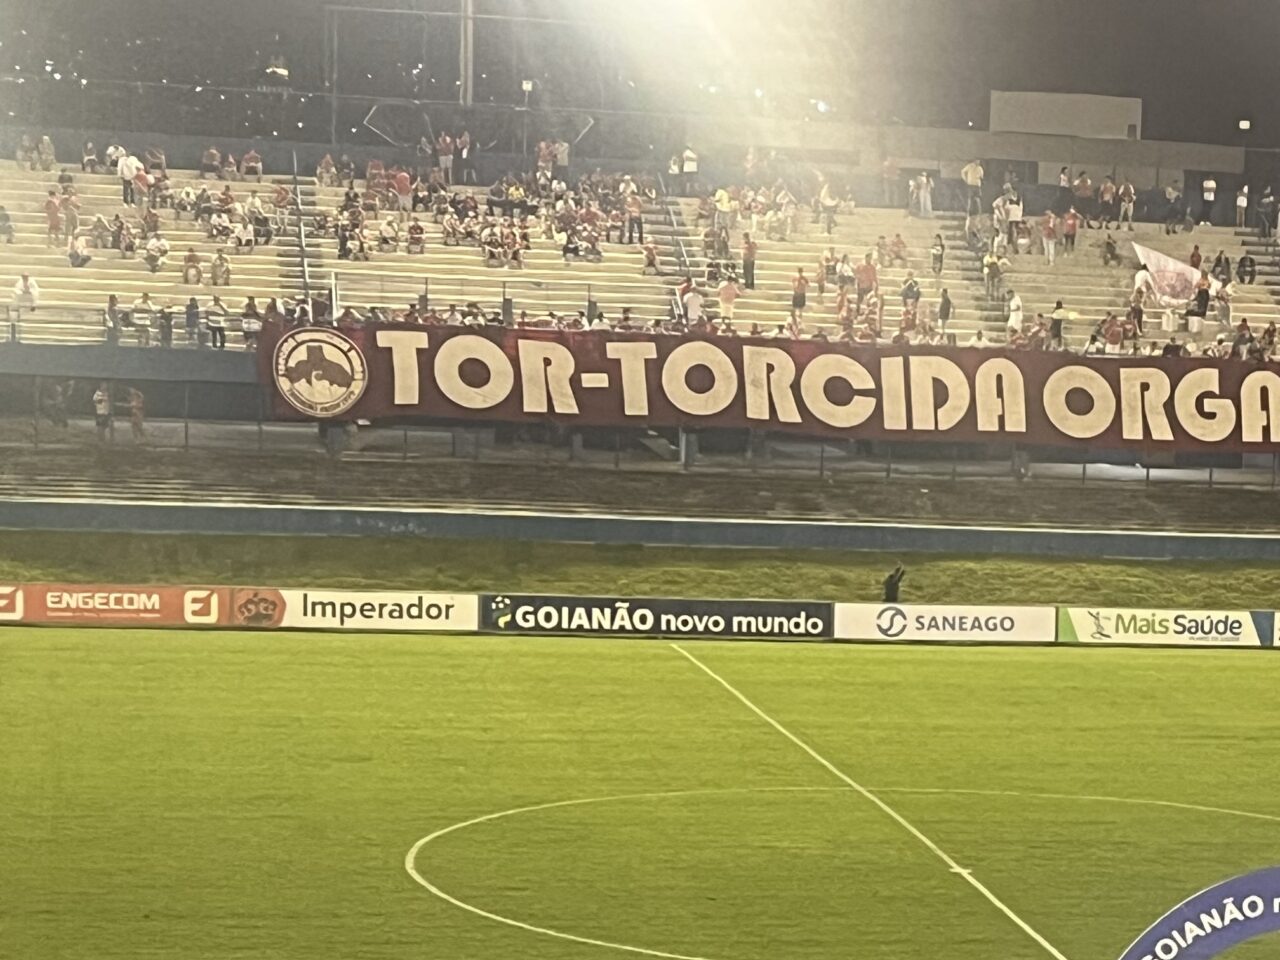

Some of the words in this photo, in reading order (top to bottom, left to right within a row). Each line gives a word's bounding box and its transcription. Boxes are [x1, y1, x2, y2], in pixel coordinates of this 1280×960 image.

[376, 330, 1027, 432] TOR-TORCIDA
[46, 591, 160, 610] ENGECOM
[302, 593, 455, 625] Imperador
[515, 602, 655, 631] GOIANÃO
[660, 613, 725, 633] novo
[732, 611, 824, 634] mundo
[915, 615, 1015, 633] SANEAGO
[1115, 613, 1170, 635] Mais
[1173, 615, 1243, 636] Saúde
